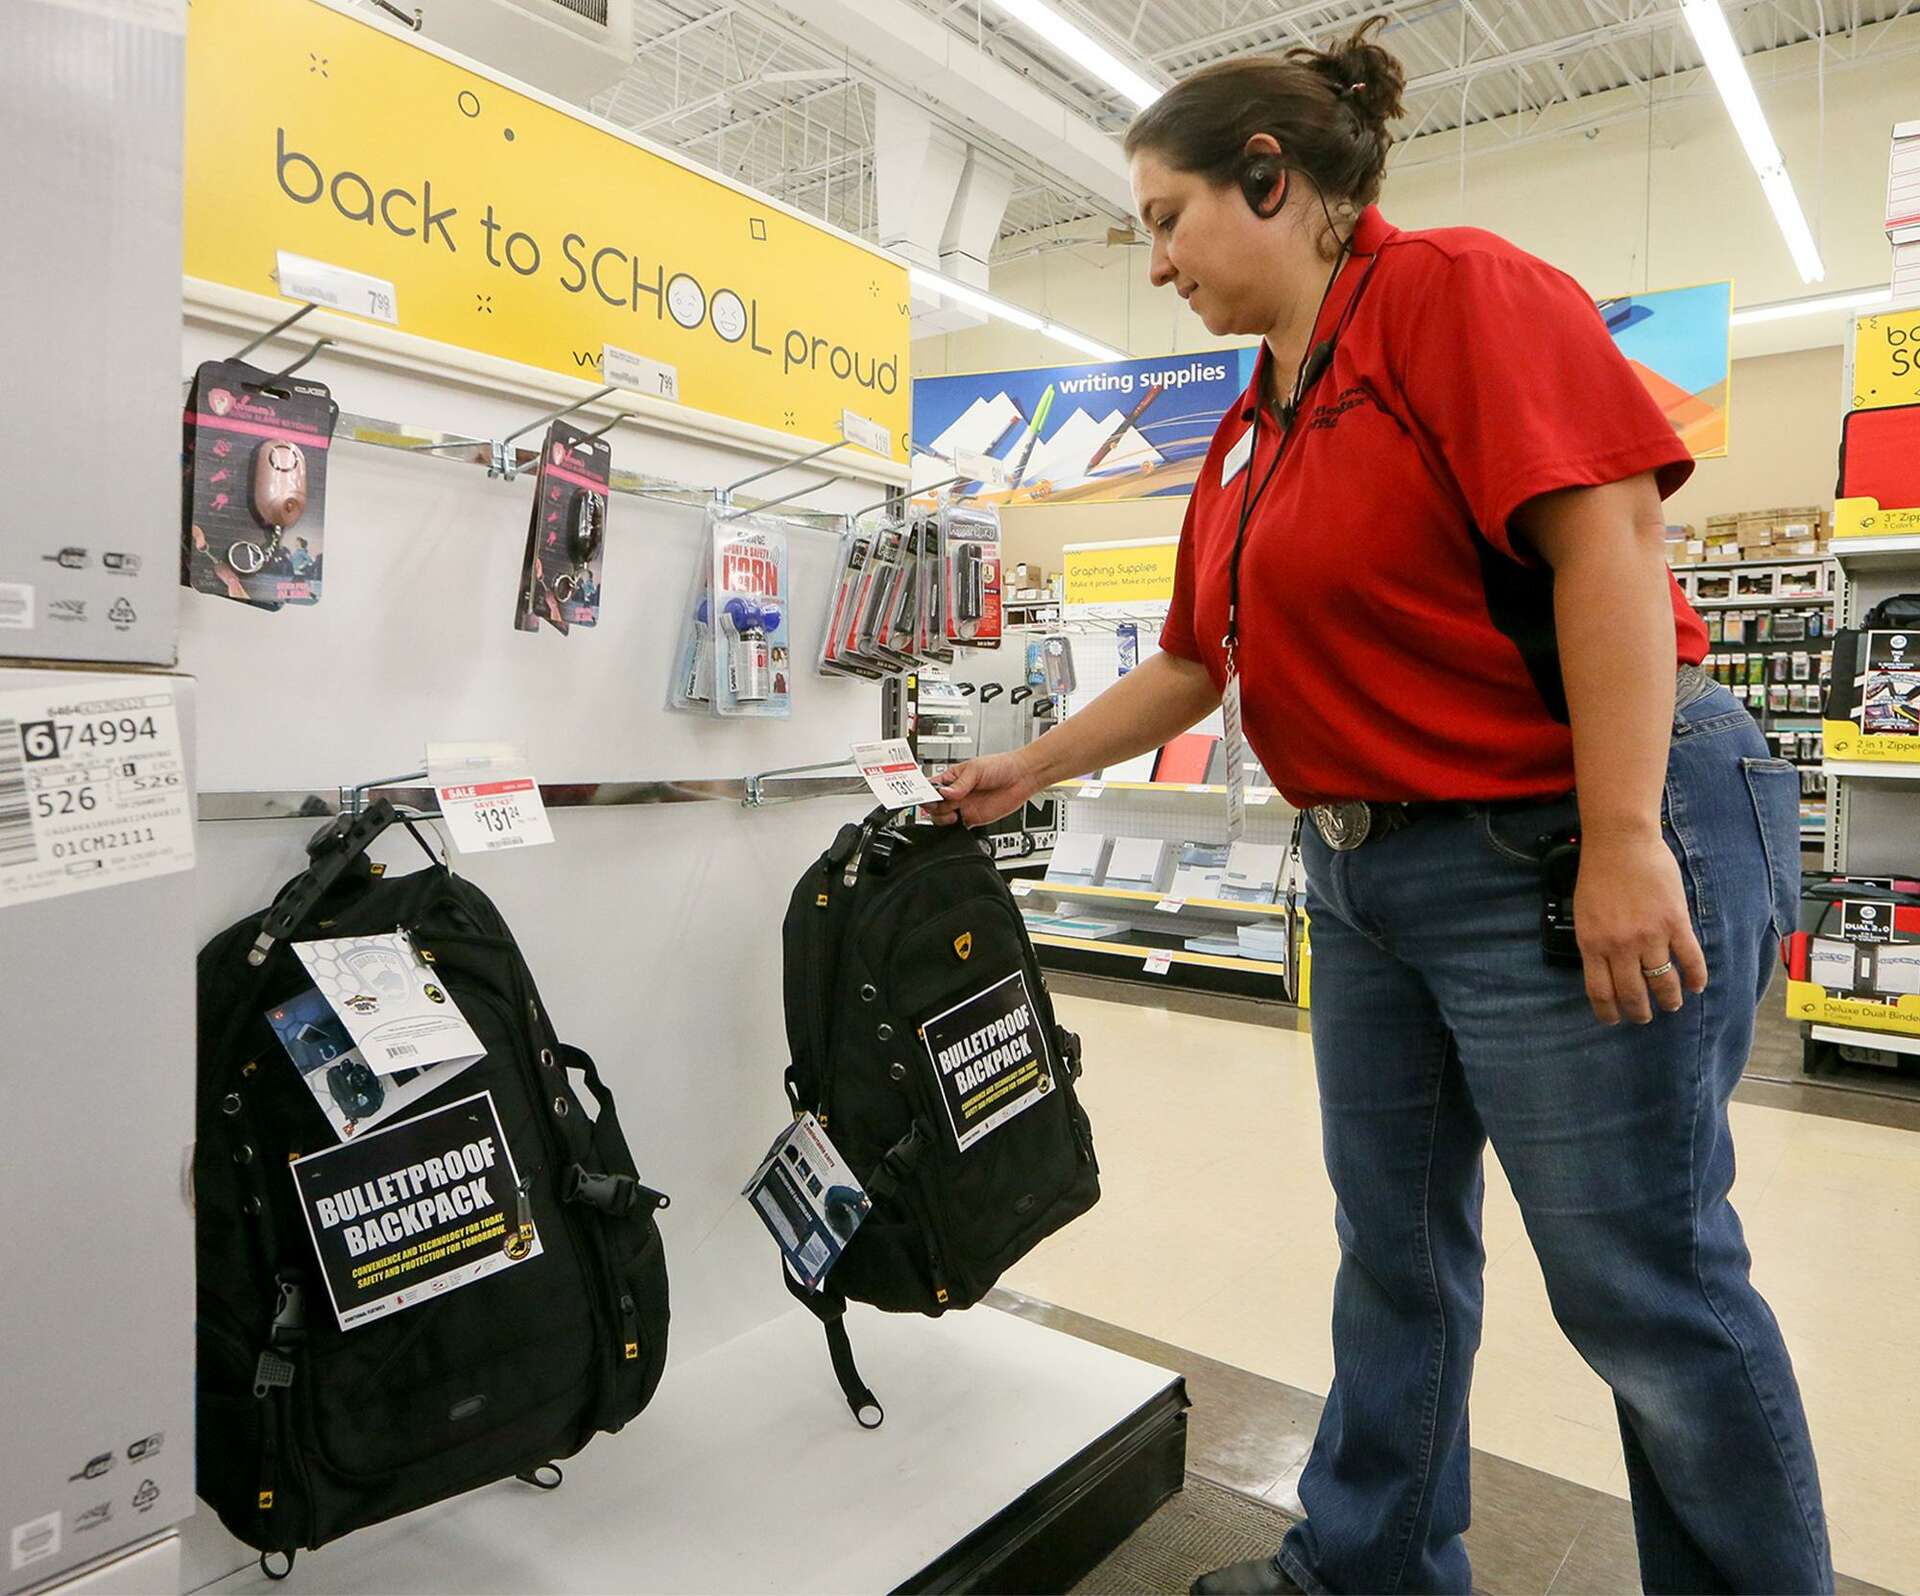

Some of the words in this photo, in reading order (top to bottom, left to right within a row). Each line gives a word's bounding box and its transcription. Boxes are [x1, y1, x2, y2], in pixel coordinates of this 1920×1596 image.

[276, 127, 458, 253] back
[480, 205, 541, 276] to
[558, 233, 772, 356] SCHOOL
[783, 329, 898, 396] proud
[1060, 373, 1134, 393] writing
[1140, 363, 1226, 390] supplies
[1070, 566, 1115, 577] Graphing
[1117, 563, 1158, 576] Supplies
[24, 716, 158, 759] 674994
[37, 786, 97, 818] 526
[133, 773, 179, 792] 526
[447, 786, 477, 800] SALE
[1824, 1003, 1860, 1015] Deluxe
[1862, 1007, 1886, 1018] Dual
[938, 1003, 1031, 1076] BULLETPROOF
[954, 1033, 1033, 1096] BACKPACK
[316, 1136, 496, 1229] BULLETPROOF
[344, 1176, 495, 1258] BACKPACK
[351, 1250, 403, 1279] CONVENIENCE
[402, 1246, 419, 1260] AND
[418, 1228, 465, 1252] TECHNOLOGY
[465, 1222, 481, 1237] FOR
[357, 1269, 385, 1289] SAFETY
[384, 1264, 401, 1279] AND
[401, 1247, 447, 1273] PROTECTION
[446, 1241, 462, 1256] FOR
